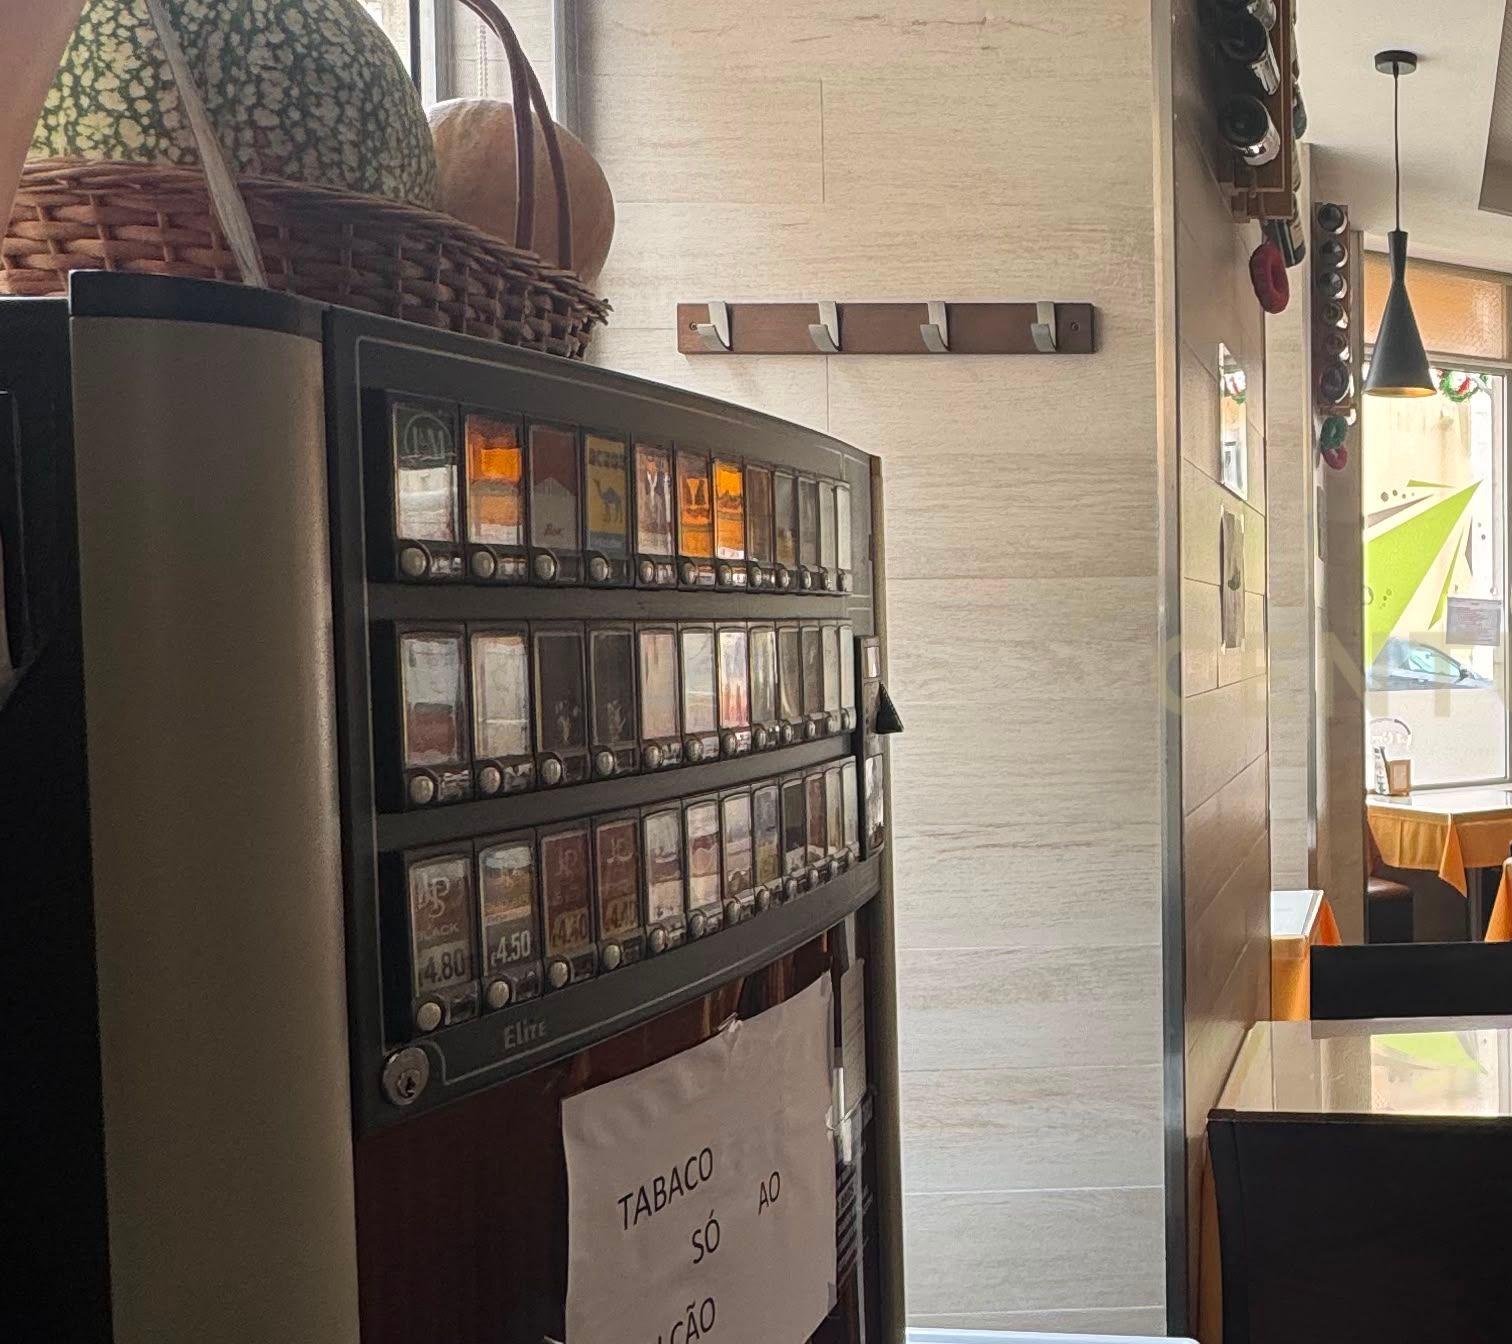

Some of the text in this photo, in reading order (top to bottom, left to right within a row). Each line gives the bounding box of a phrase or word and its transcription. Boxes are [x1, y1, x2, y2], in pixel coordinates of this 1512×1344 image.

[617, 1147, 713, 1231] TABACO
[692, 1171, 781, 1264] SÓ AO
